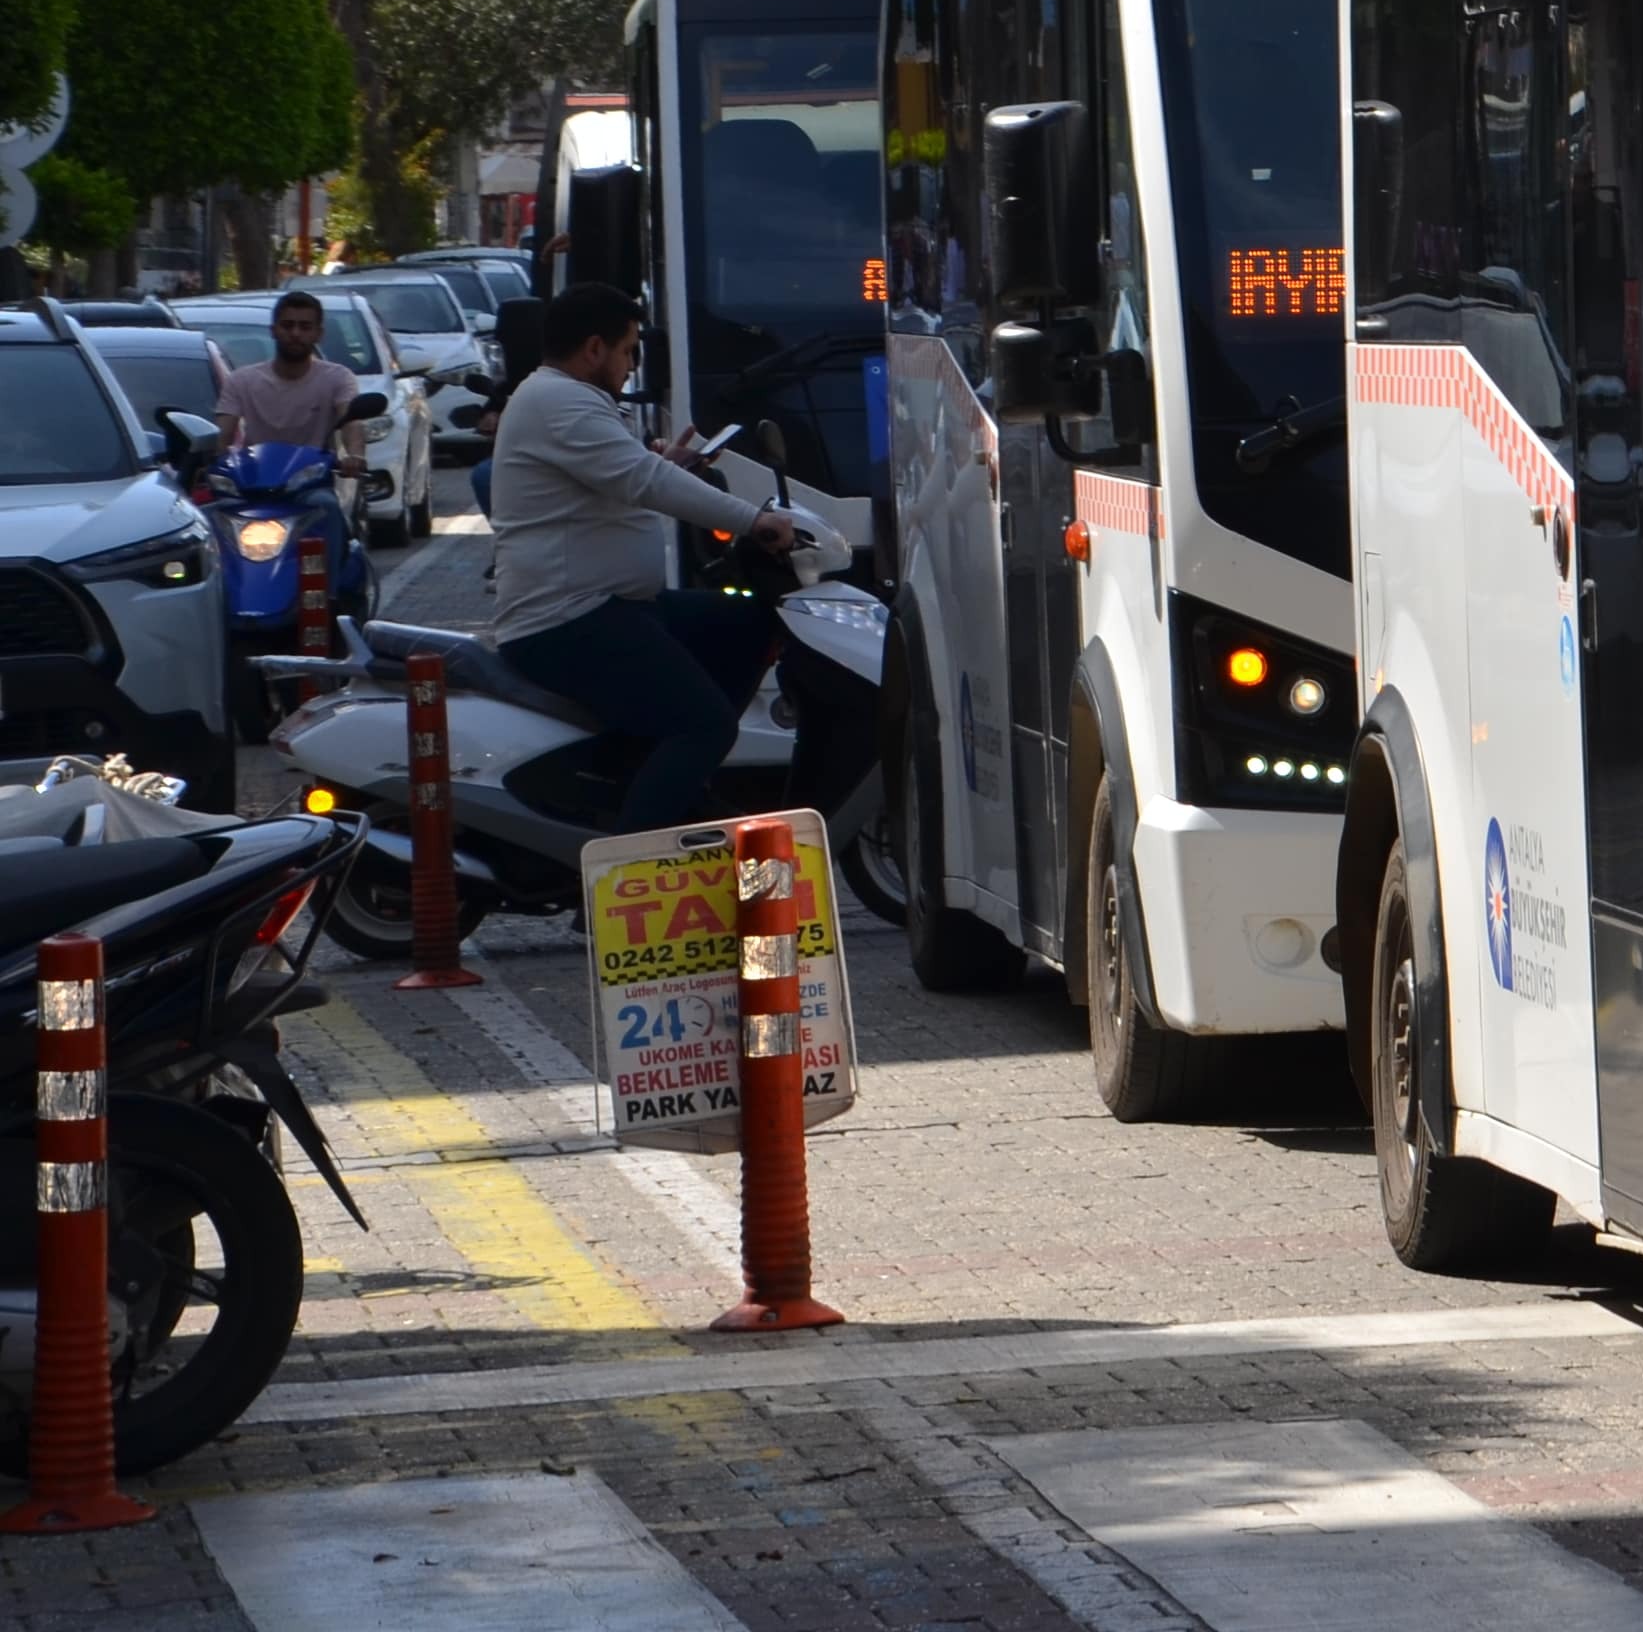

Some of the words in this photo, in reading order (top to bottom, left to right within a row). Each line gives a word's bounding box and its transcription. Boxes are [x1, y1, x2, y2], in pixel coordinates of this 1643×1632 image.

[607, 879, 816, 945] TAI
[604, 946, 674, 969] 0242
[685, 936, 737, 959] 512
[625, 986, 658, 999] Lütfen
[617, 998, 685, 1049] 24
[617, 1060, 729, 1096] BEKLEME
[626, 1091, 697, 1123] PARK
